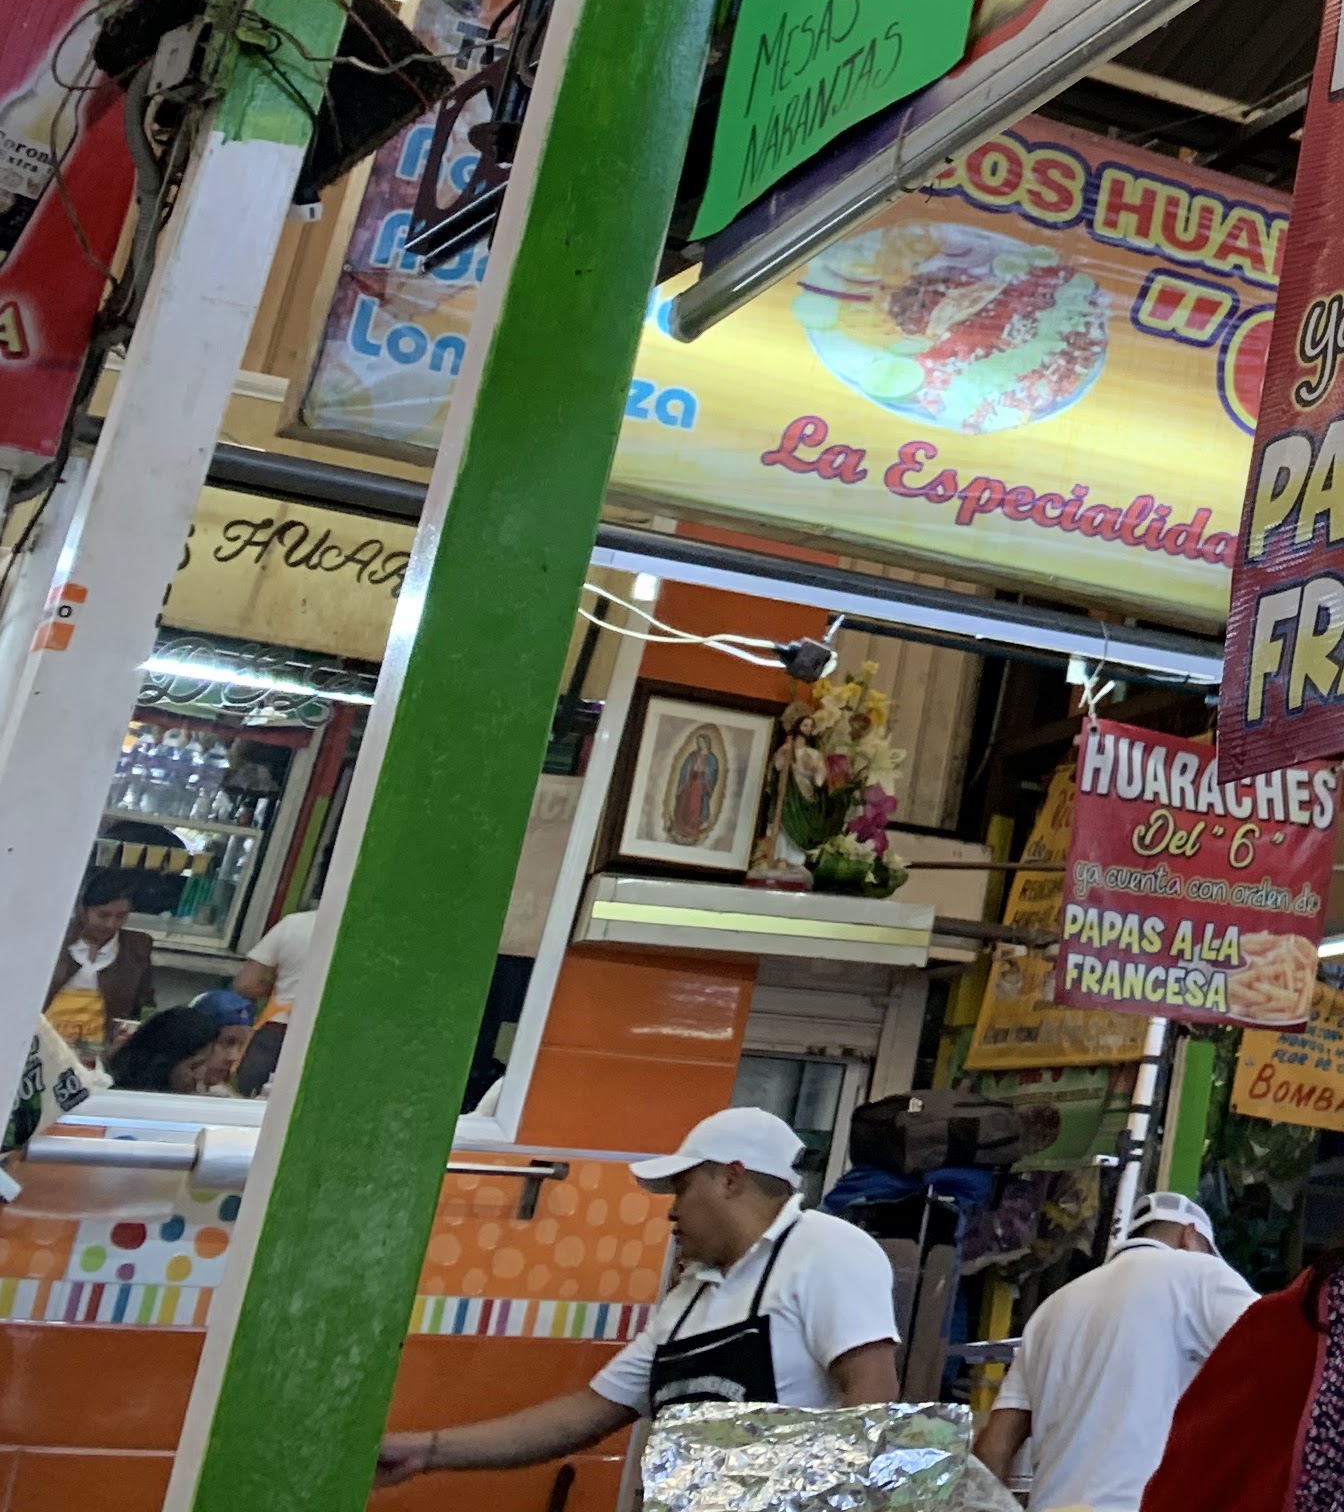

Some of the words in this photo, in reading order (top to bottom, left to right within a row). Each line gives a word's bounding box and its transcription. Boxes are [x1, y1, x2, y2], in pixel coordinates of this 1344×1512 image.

[738, 22, 904, 188] NARANJAS
[760, 414, 869, 486] La
[1132, 808, 1206, 858] Del
[1073, 859, 1100, 900] ya
[1103, 862, 1183, 897] cuenta
[1185, 881, 1230, 904] con
[1229, 877, 1292, 913] orden
[1063, 902, 1165, 955] PAPAS
[1169, 919, 1194, 963] A
[1199, 922, 1241, 967] LA
[1064, 952, 1229, 1014] FRANCESA
